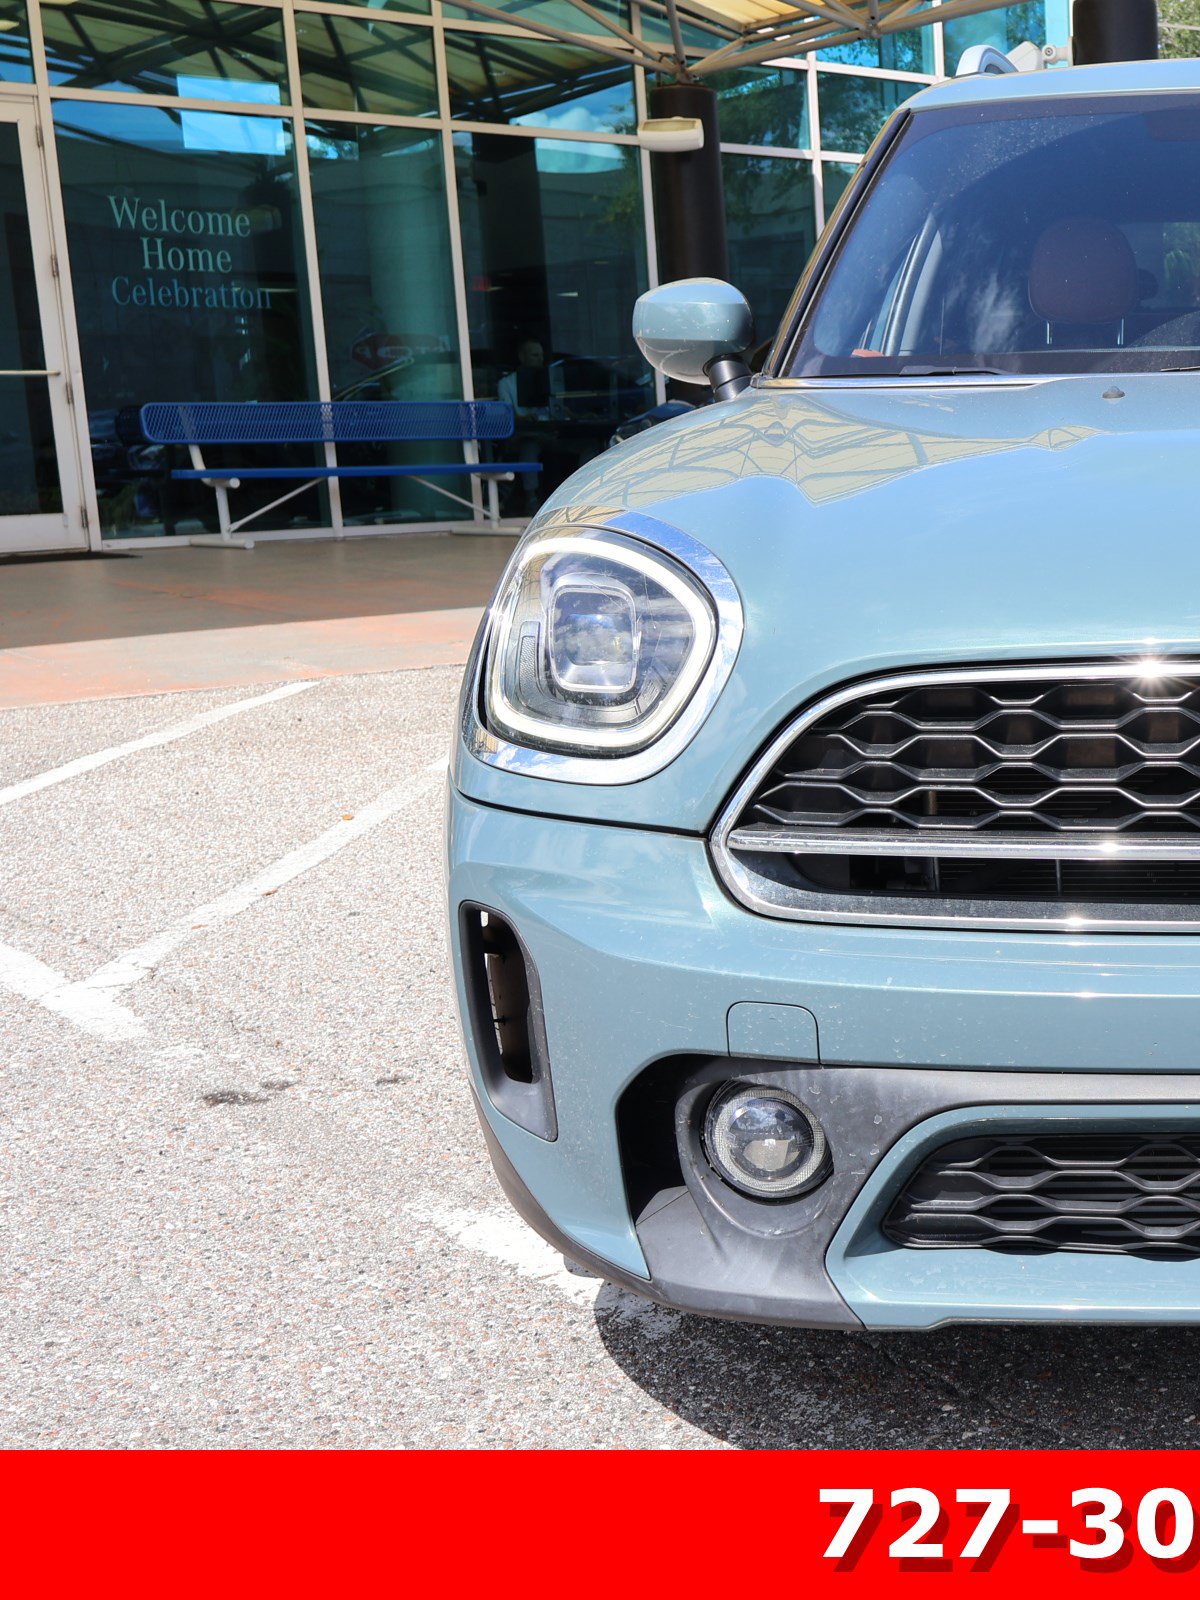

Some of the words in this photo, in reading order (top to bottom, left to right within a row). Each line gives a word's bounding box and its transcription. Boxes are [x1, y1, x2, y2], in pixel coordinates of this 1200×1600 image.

[107, 195, 251, 238] Welcome
[139, 236, 233, 273] Home
[111, 275, 273, 310] Celebration
